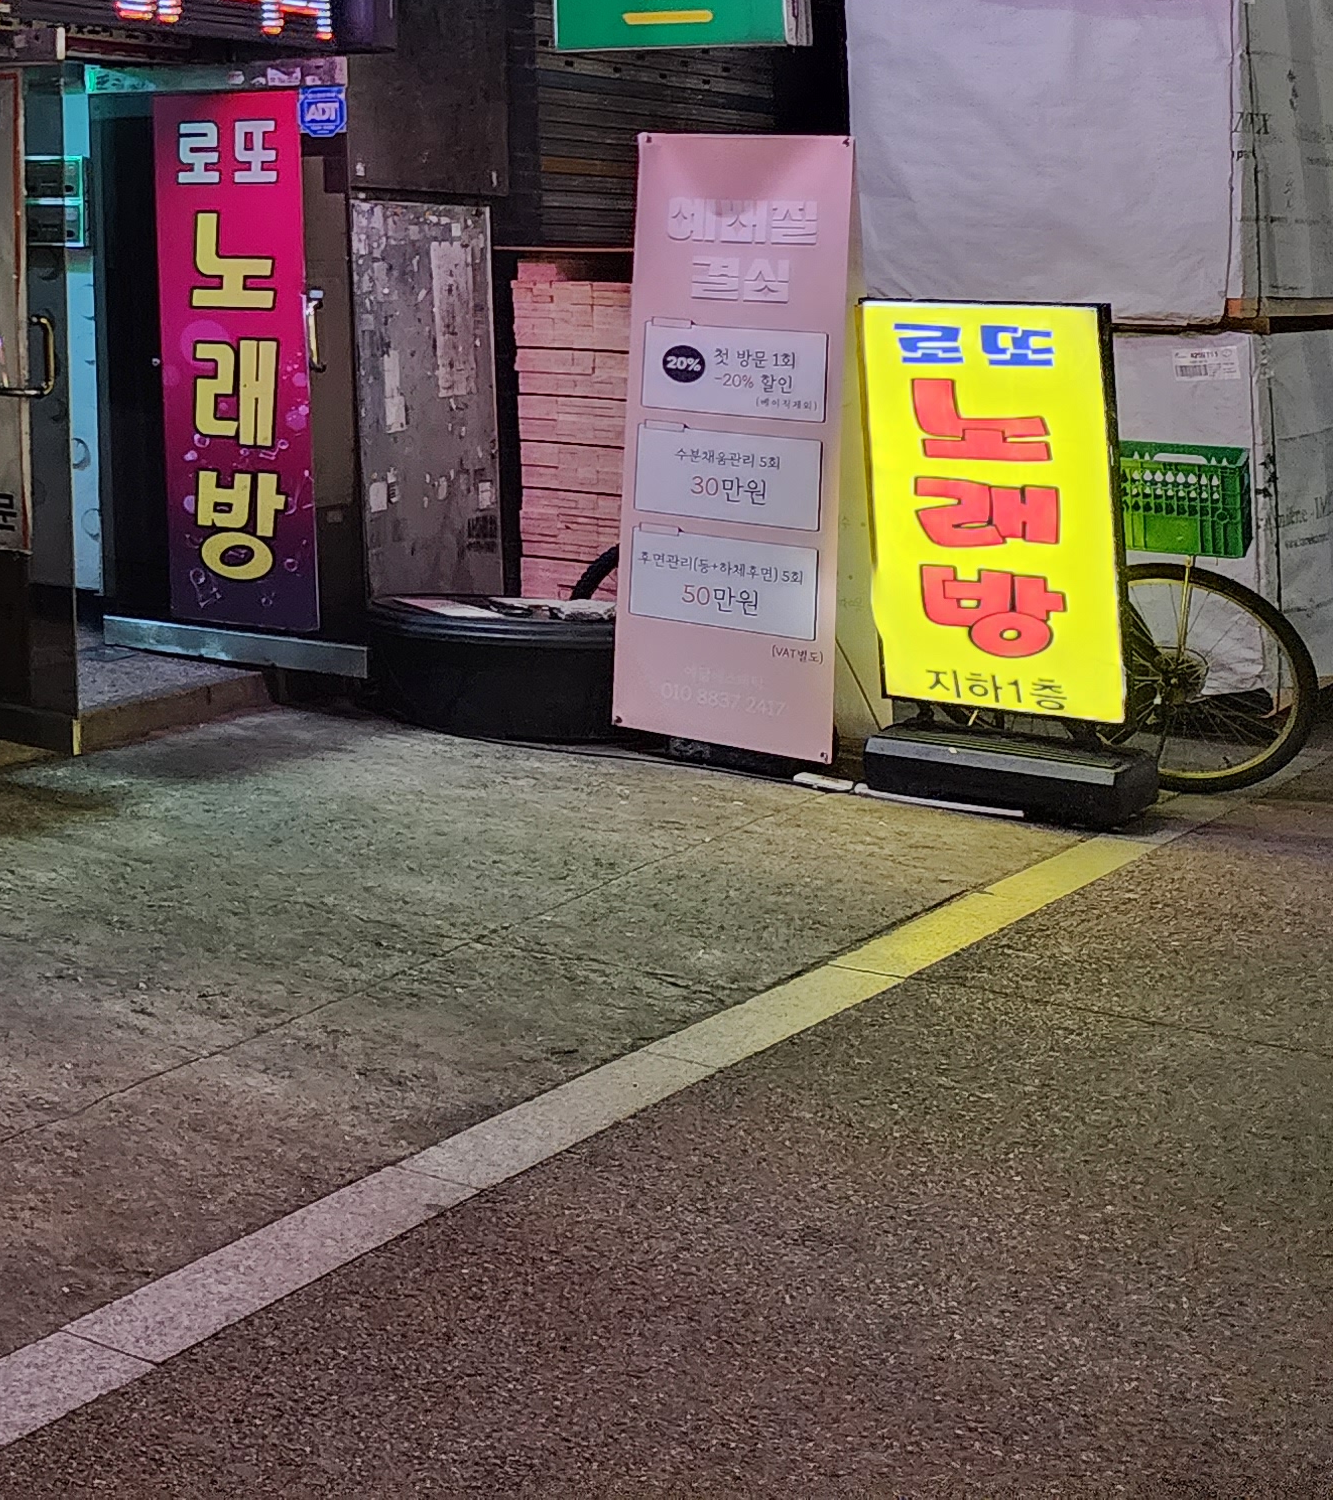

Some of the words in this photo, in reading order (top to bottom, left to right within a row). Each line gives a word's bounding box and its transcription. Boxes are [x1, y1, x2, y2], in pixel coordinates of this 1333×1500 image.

[304, 102, 339, 123] ADT
[175, 119, 280, 186] 로또
[713, 347, 730, 368] 첫
[736, 349, 769, 369] 방문
[773, 352, 797, 370] 1회
[894, 322, 1054, 368] 로또
[665, 355, 703, 373] 20%
[190, 211, 287, 581] 노래방
[760, 374, 794, 395] 할인
[758, 455, 782, 471] 5회
[689, 475, 768, 506] 30만원
[909, 376, 1067, 659] 노래방
[781, 569, 805, 586] 5회
[681, 584, 760, 617] 50만원
[922, 667, 1071, 713] 지하1층
